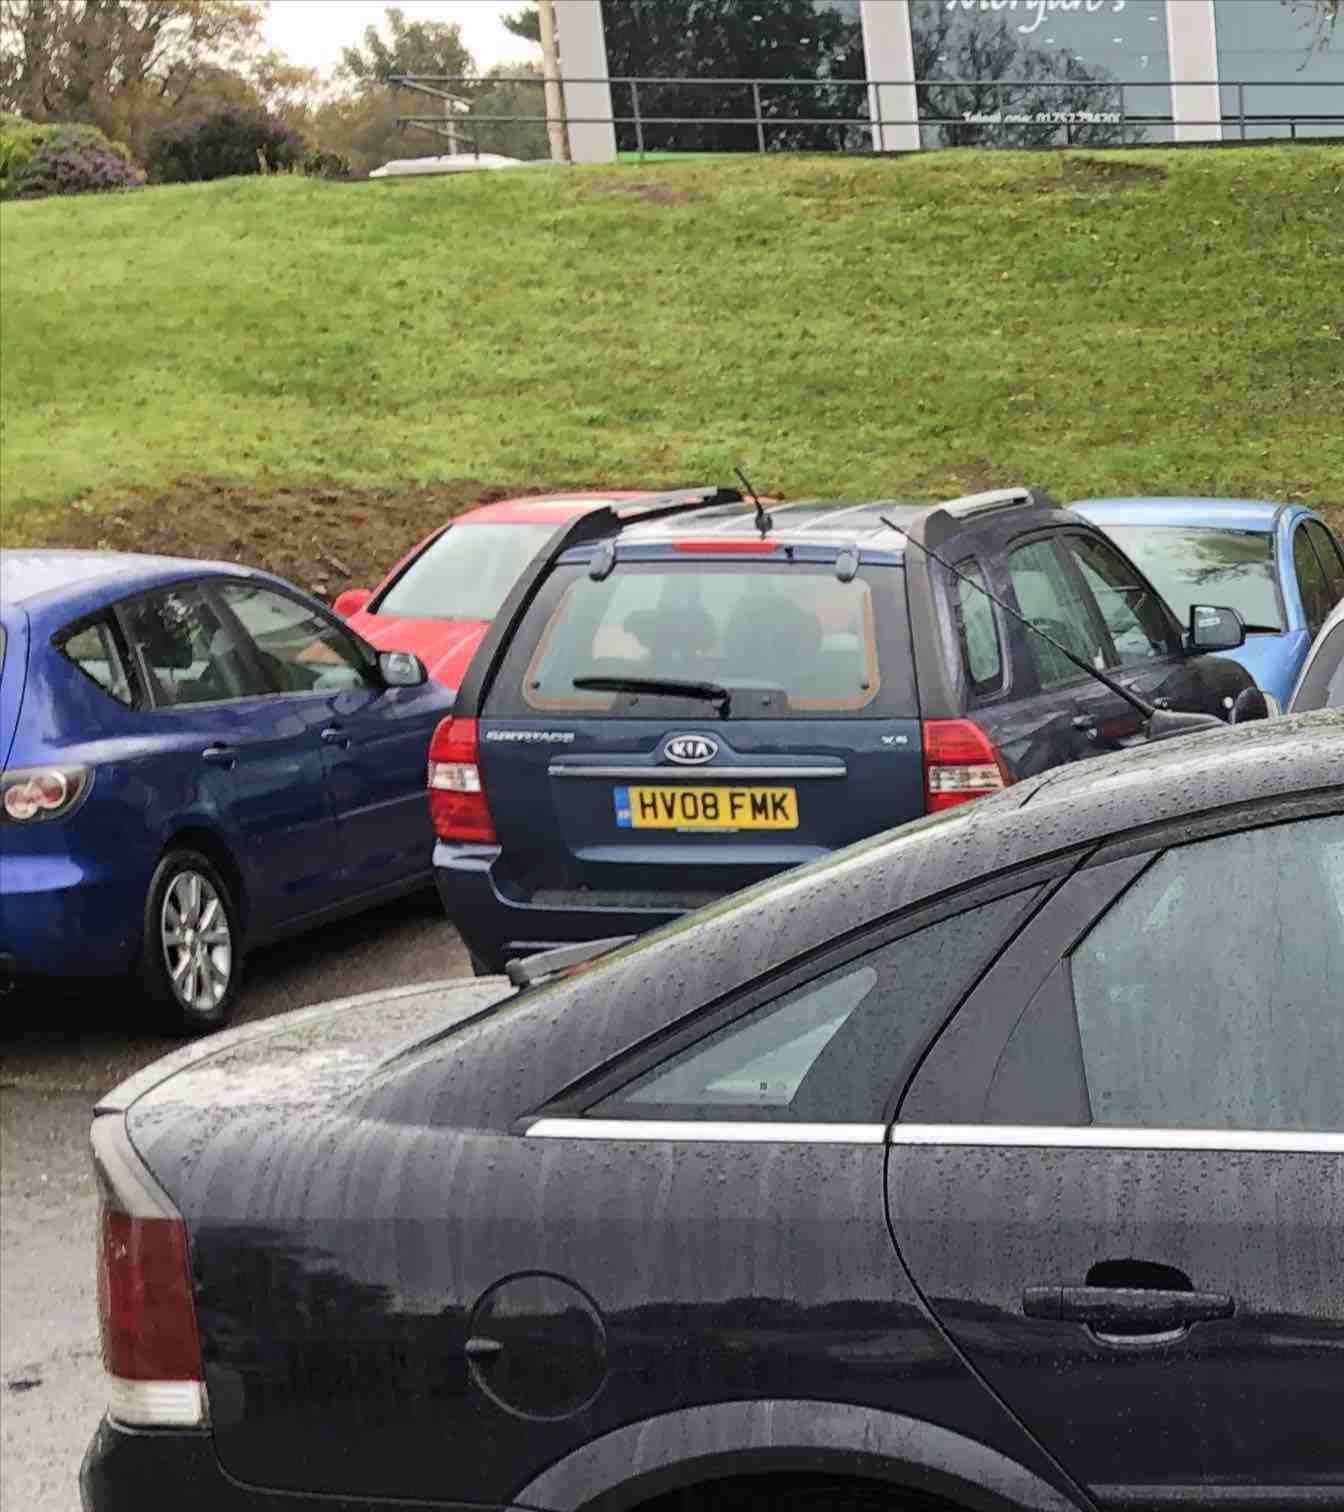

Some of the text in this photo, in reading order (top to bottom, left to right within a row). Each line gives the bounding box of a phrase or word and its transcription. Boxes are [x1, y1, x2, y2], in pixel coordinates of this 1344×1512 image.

[671, 742, 710, 759] KIA
[639, 791, 790, 821] HV08 FMK
